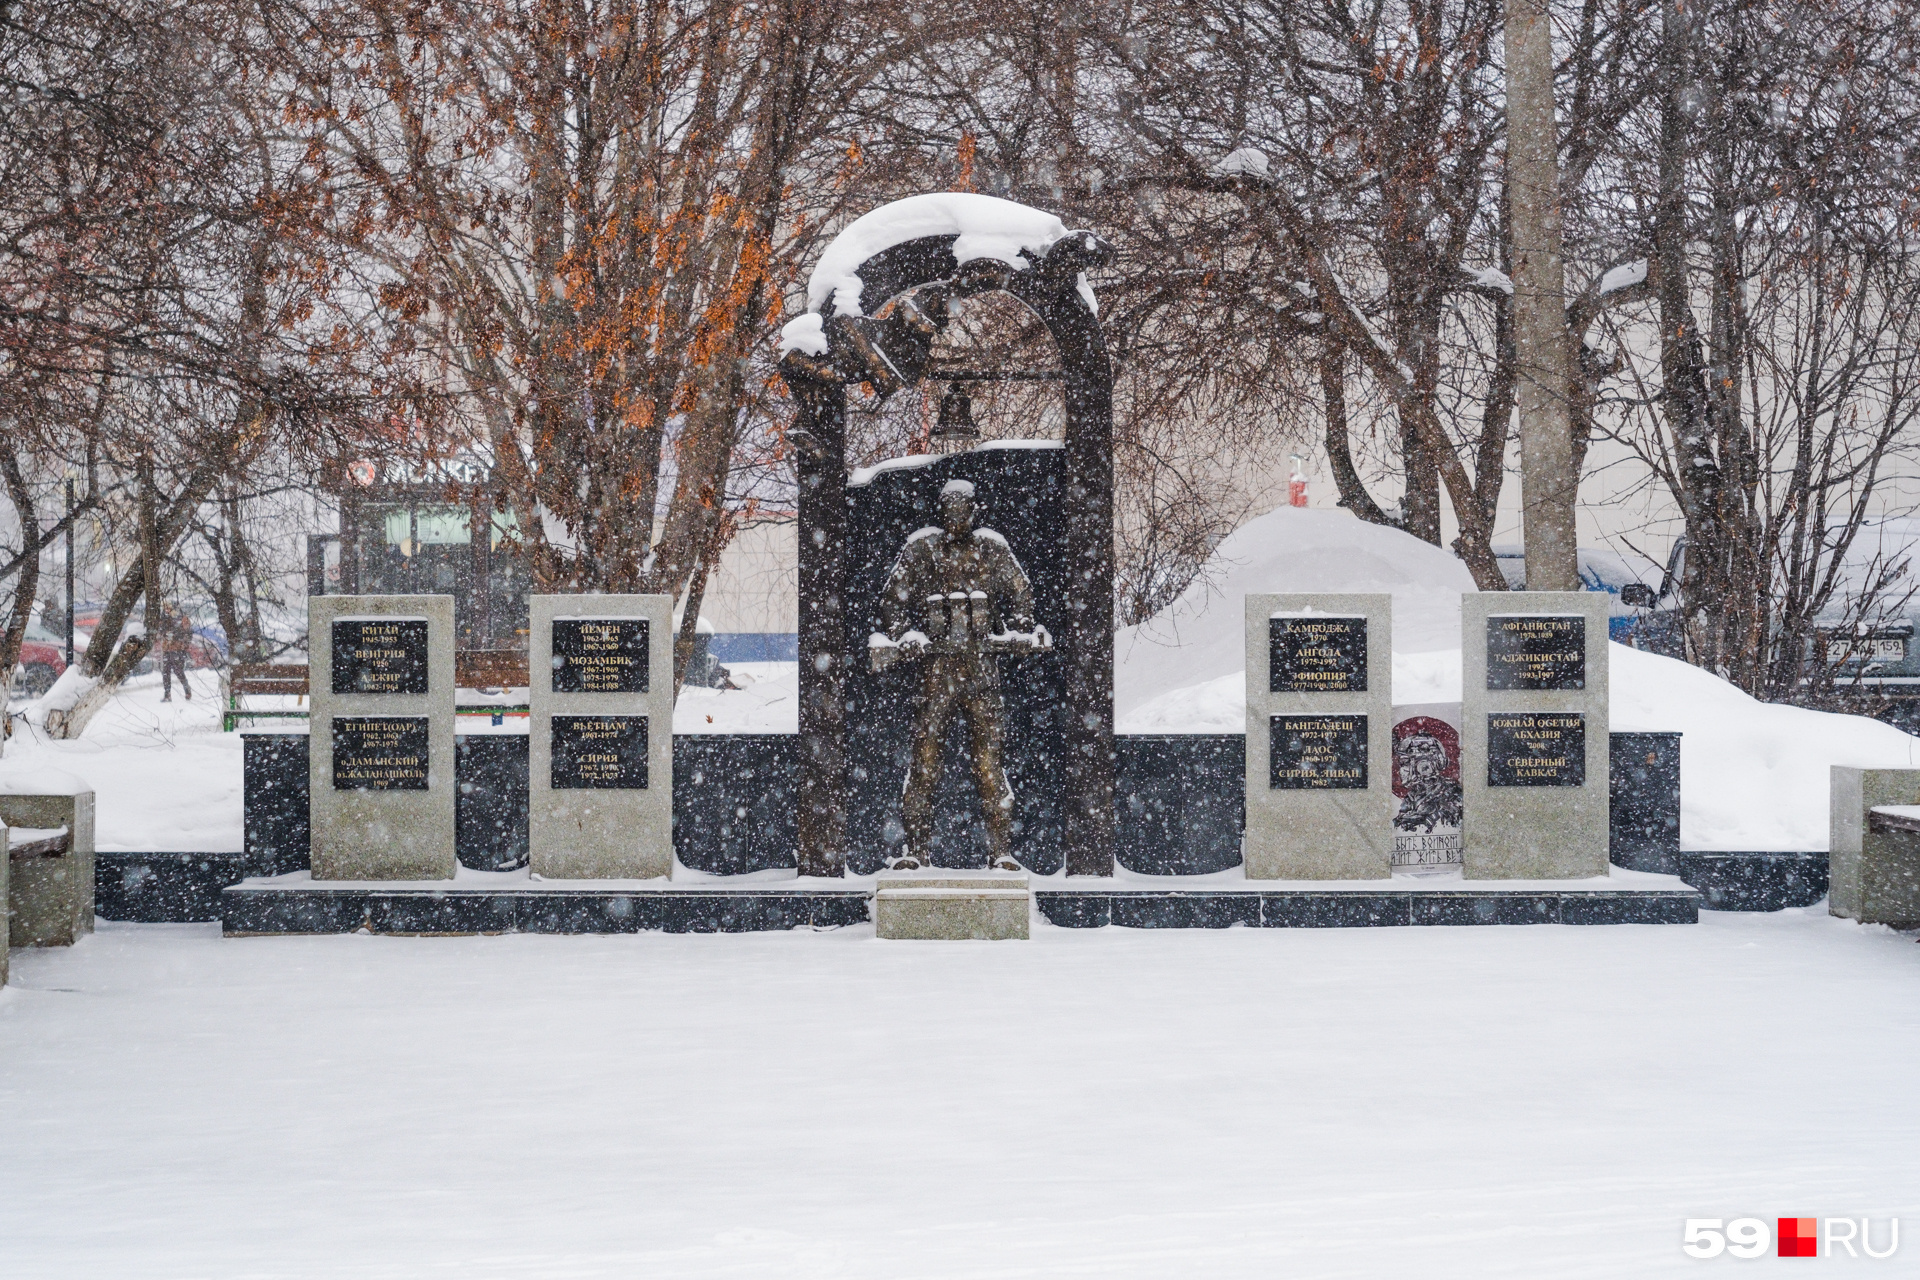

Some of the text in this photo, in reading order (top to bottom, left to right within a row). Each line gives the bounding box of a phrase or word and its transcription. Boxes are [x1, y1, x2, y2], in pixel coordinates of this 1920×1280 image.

[362, 625, 398, 634] КИТАЙ
[581, 624, 620, 633] ЙЕМЕН
[1286, 624, 1350, 633] КАМБОДЖА
[1502, 622, 1570, 630] АФГАНИСТАН
[1880, 641, 1901, 651] 159
[356, 650, 405, 658] ВЕНГРИЯ
[1494, 654, 1578, 662] ТАДЖИКИСТАН
[362, 674, 400, 683] АЛЖИР
[573, 722, 626, 730] ВЬЕТНАМ
[1285, 722, 1353, 730] БАНГЛАДЕШ
[1493, 719, 1580, 727] ЮЖНАЯ ОСЕТИЯ
[346, 723, 416, 732] ЕГИПЕТ(ОАР)
[341, 756, 418, 766] о.ДАМАНСКИЙ
[580, 754, 618, 762] СИРИЯ
[1507, 757, 1565, 766] СЕВЕРНЫЙ
[1279, 770, 1319, 778] СИРИЯ,
